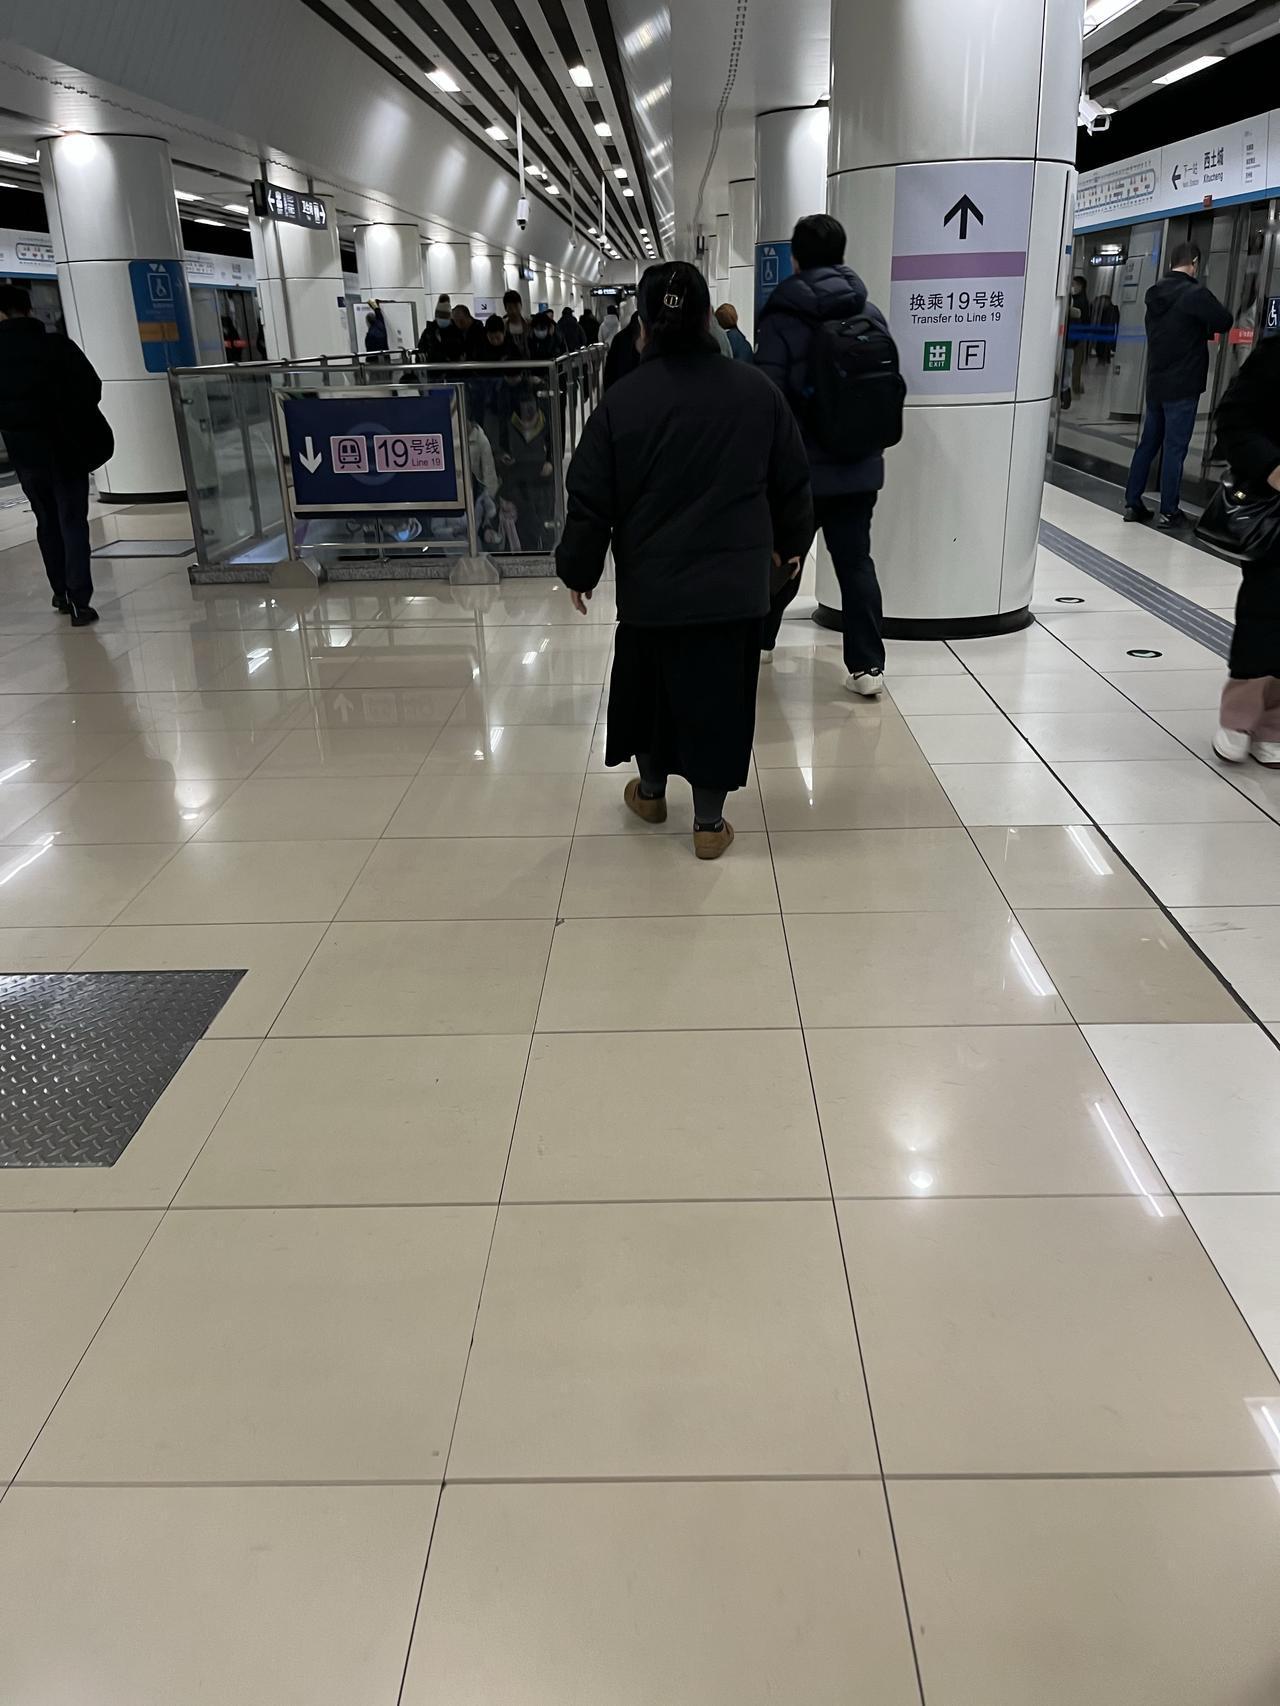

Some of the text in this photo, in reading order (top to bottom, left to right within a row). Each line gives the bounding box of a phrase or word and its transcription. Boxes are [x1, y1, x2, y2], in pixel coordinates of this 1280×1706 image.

[1203, 147, 1224, 170] 西土城
[1203, 172, 1224, 183] Xitucheng
[909, 291, 1005, 311] 换乘19号线
[911, 311, 1001, 325] Transfer to Line 19
[965, 345, 979, 366] F
[411, 458, 441, 467] Line 19
